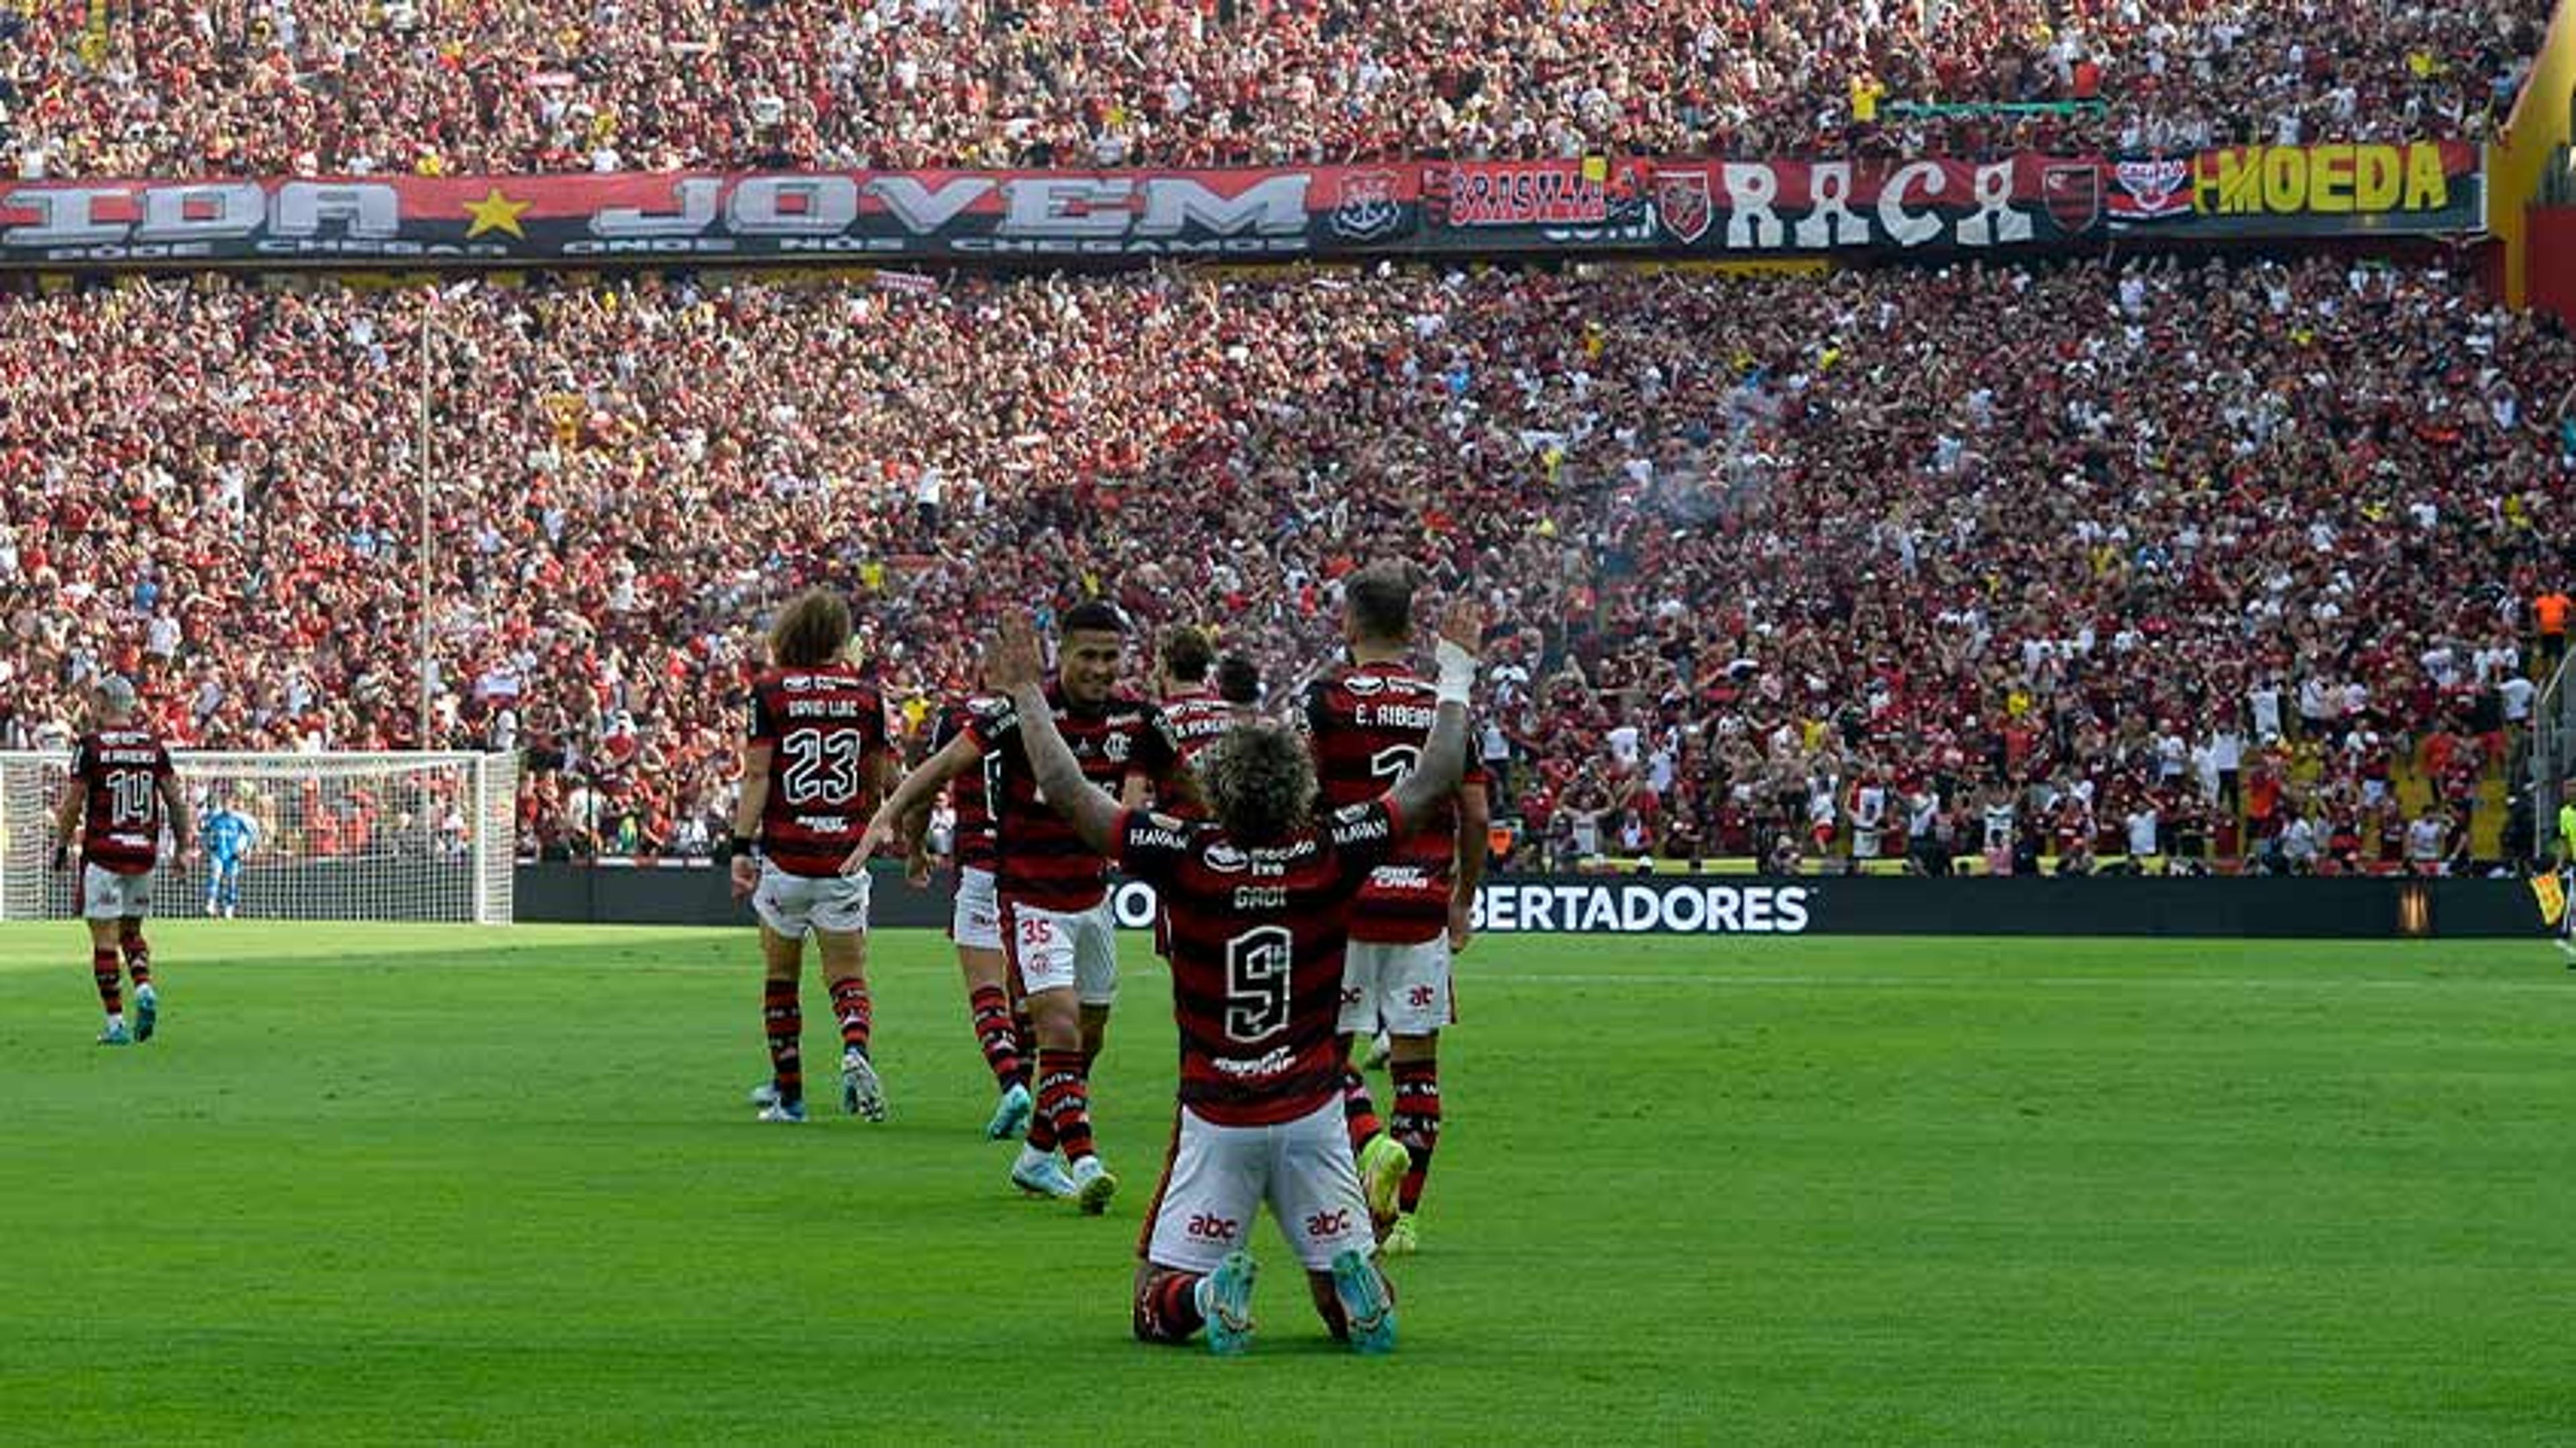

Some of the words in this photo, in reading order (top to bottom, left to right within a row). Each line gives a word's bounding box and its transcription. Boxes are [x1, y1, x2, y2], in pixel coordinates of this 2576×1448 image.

[2, 180, 402, 245] IDA
[588, 172, 1311, 238] JOVEM
[1356, 704, 1373, 727] E.
[1377, 705, 1437, 729] RIBEIR
[782, 728, 861, 805] 23
[106, 768, 153, 827] 14
[1021, 919, 1052, 942] 35
[1226, 925, 1293, 1043] 9
[1187, 1212, 1238, 1239] abc
[1305, 1208, 1351, 1237] abc
